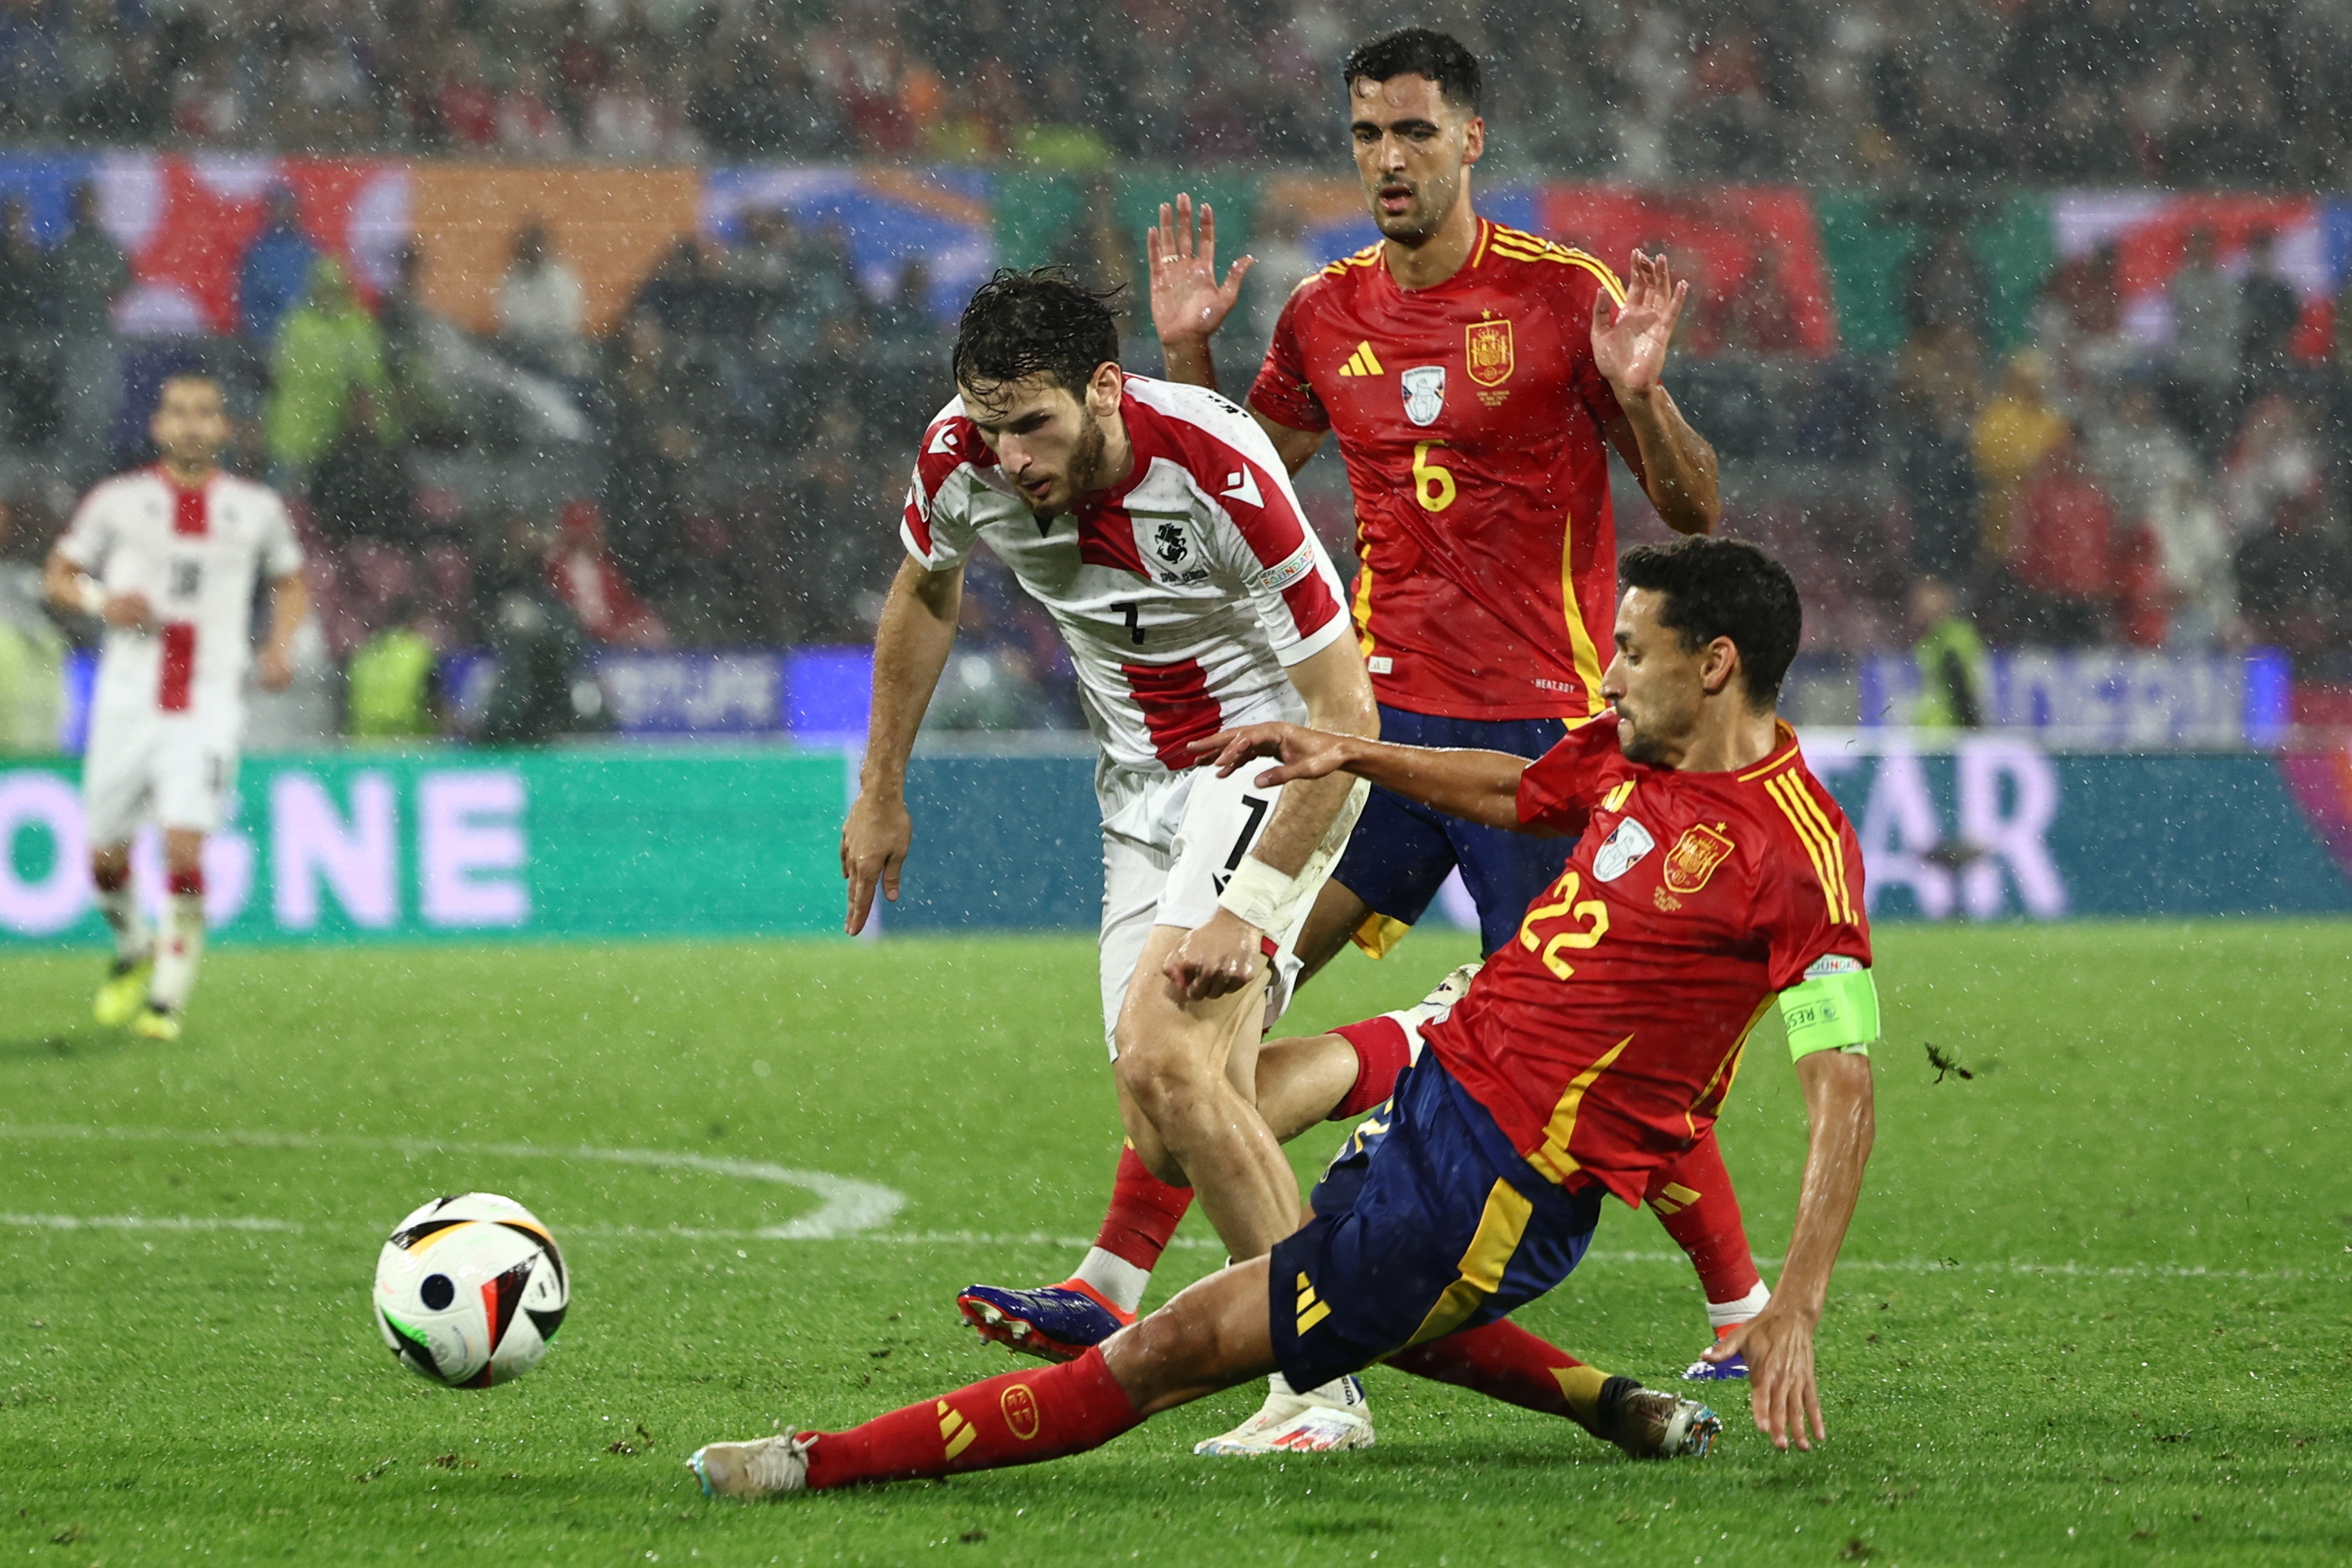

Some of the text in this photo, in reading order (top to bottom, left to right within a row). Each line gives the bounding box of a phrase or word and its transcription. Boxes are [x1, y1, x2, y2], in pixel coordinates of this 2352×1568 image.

[1412, 438, 1456, 512] 6
[1110, 602, 1145, 646] 7
[1224, 794, 1269, 871] 7
[1519, 870, 1610, 982] 22
